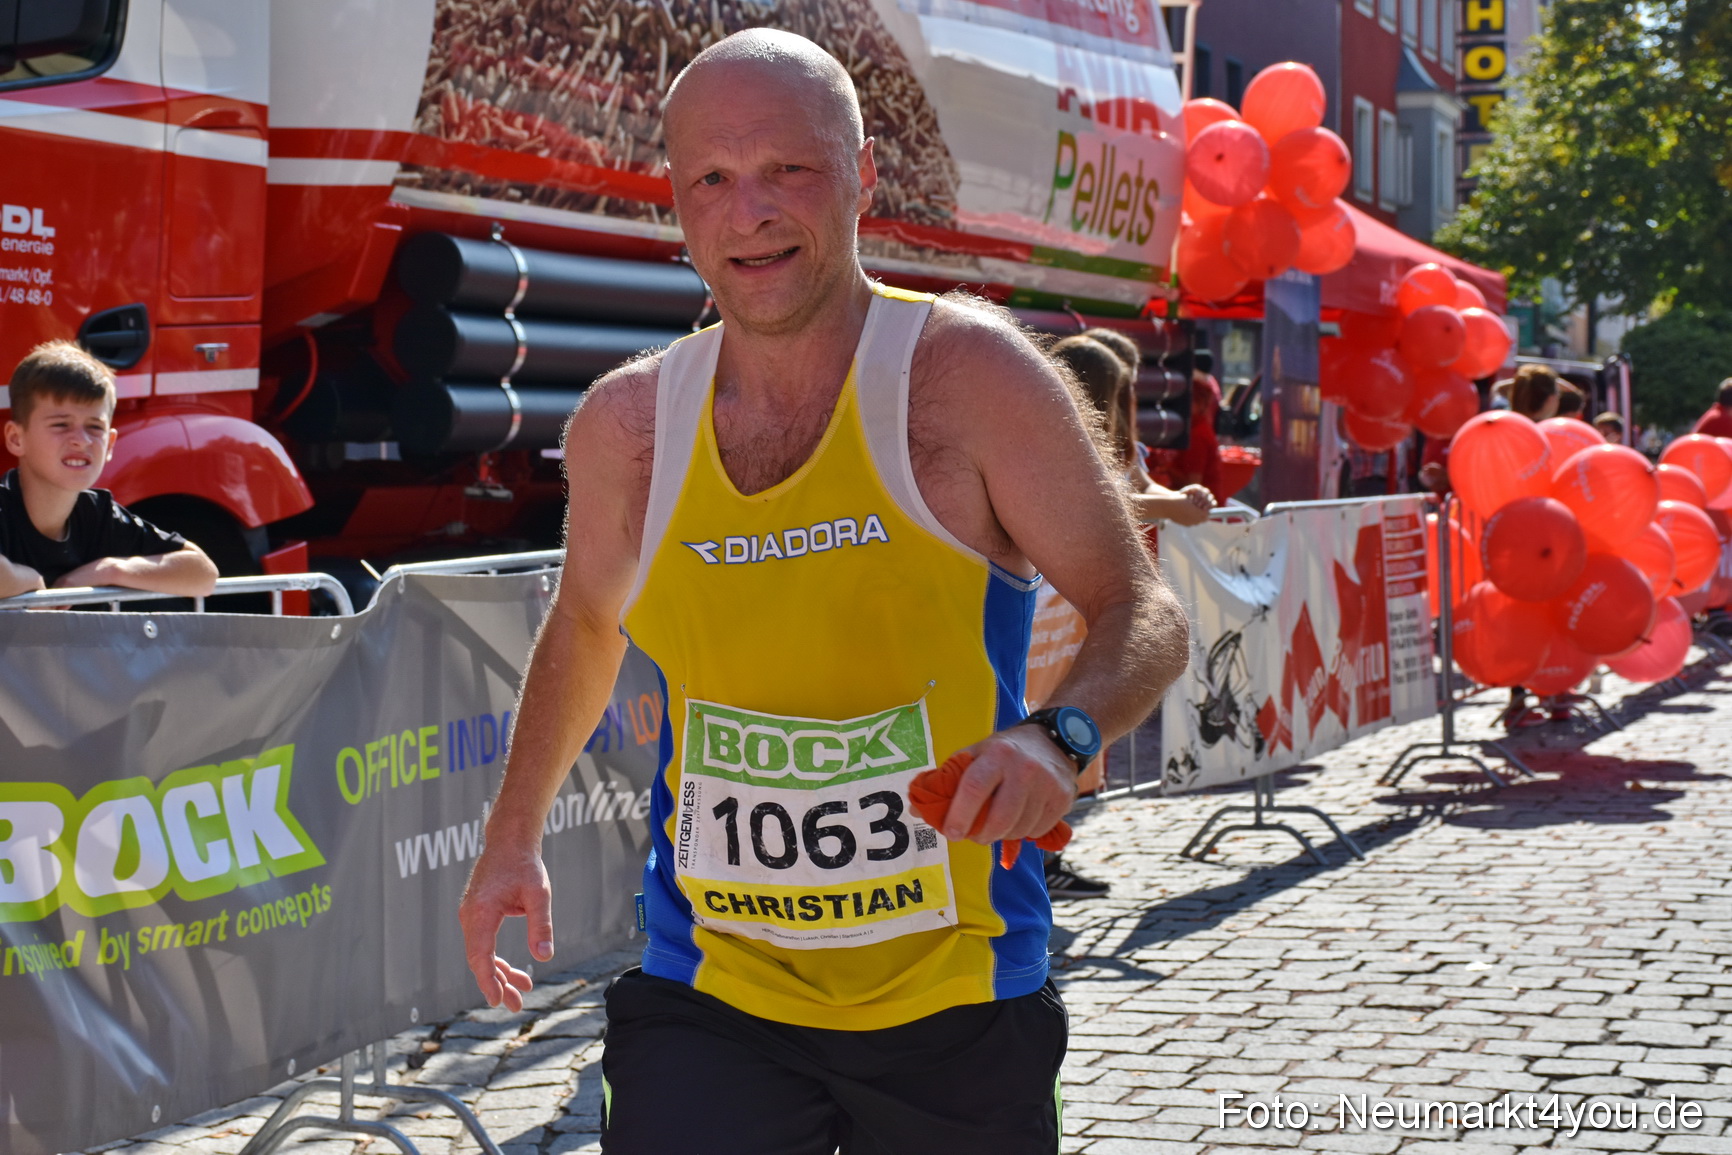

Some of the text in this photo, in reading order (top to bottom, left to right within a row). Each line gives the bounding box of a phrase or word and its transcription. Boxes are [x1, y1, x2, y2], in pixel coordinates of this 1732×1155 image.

[0, 203, 56, 238] DL
[1043, 129, 1160, 246] Pellets
[724, 514, 890, 565] DIADORA
[335, 724, 441, 805] OFFICE
[447, 702, 624, 773] INDRY
[705, 717, 900, 777] BOCK
[0, 759, 308, 905] BOCK
[712, 790, 910, 870] 1063
[0, 882, 332, 981] nspired by smart concepts
[703, 878, 925, 922] CHRISTIAN
